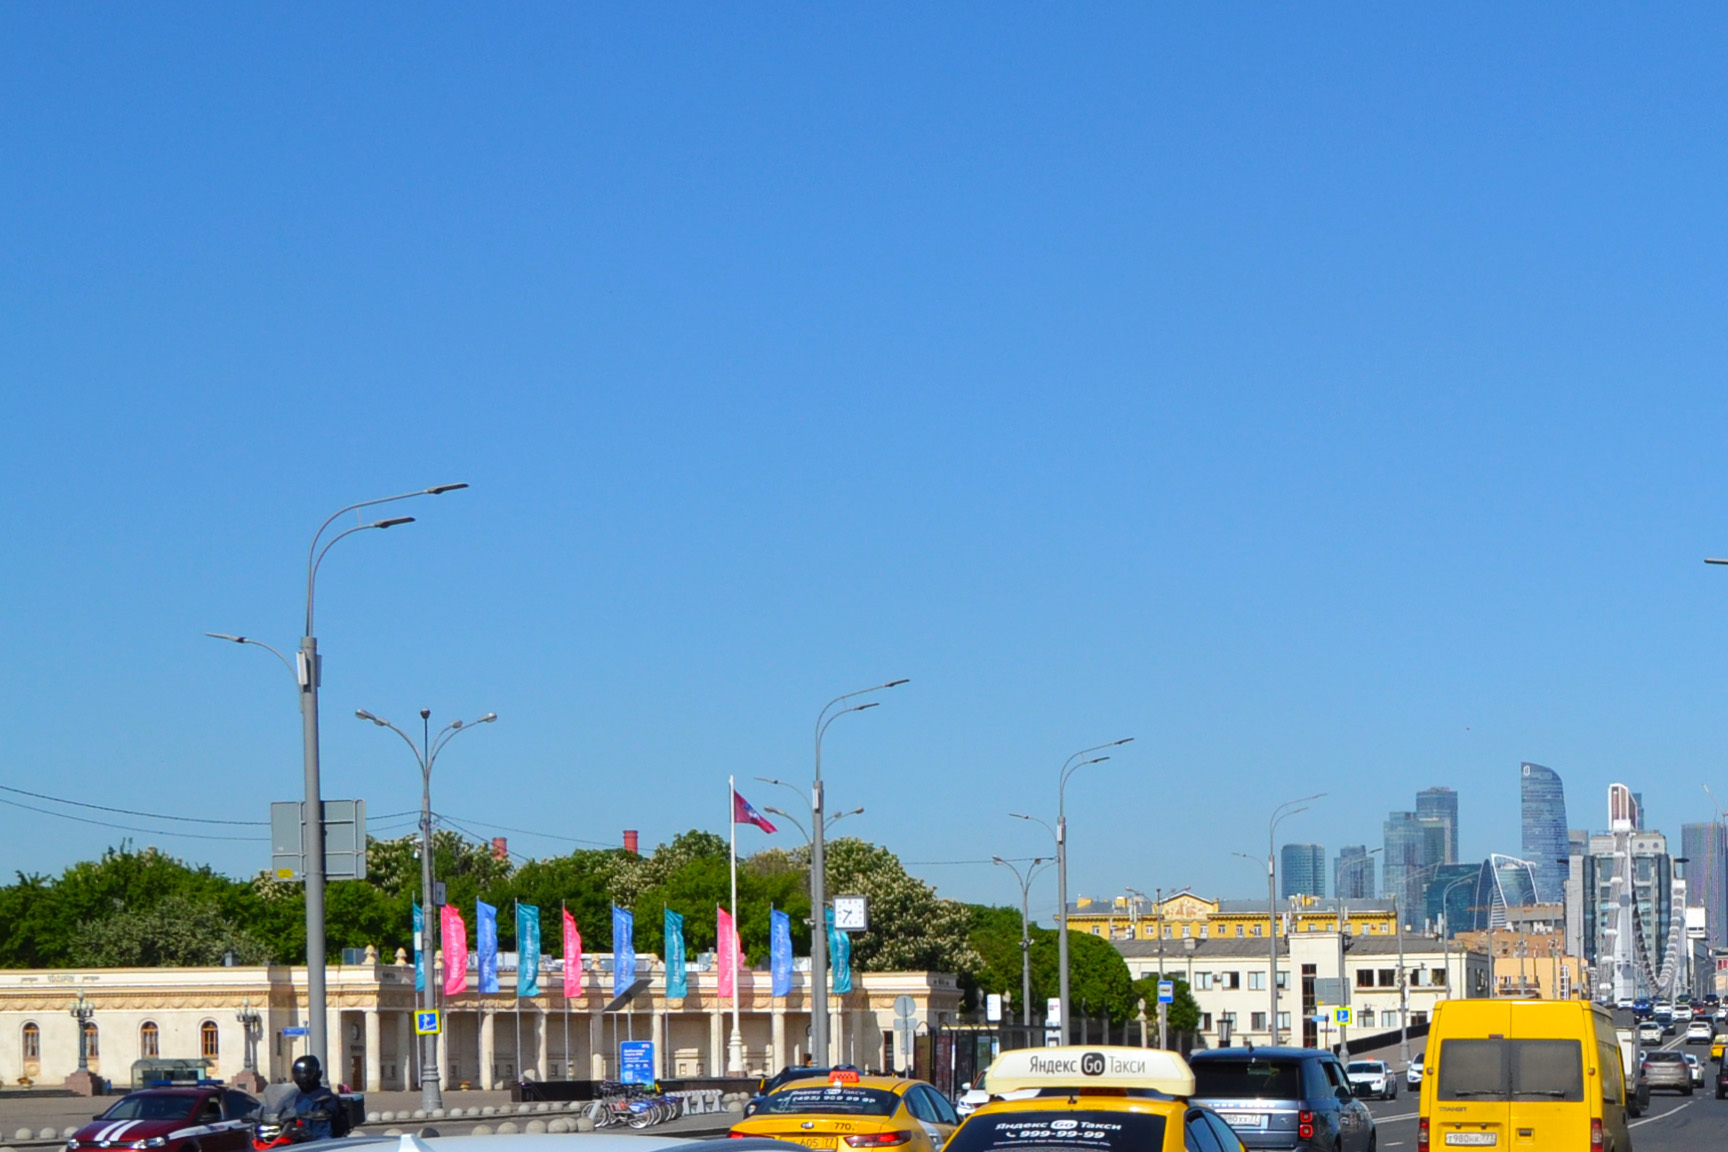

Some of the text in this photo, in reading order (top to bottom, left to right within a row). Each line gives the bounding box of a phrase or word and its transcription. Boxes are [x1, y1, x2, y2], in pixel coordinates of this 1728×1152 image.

[1030, 1055, 1146, 1073] Яндекс Go Такси
[995, 1121, 1049, 1130] Яндекс
[1080, 1121, 1122, 1130] Такси
[1019, 1130, 1106, 1139] 999-99-99
